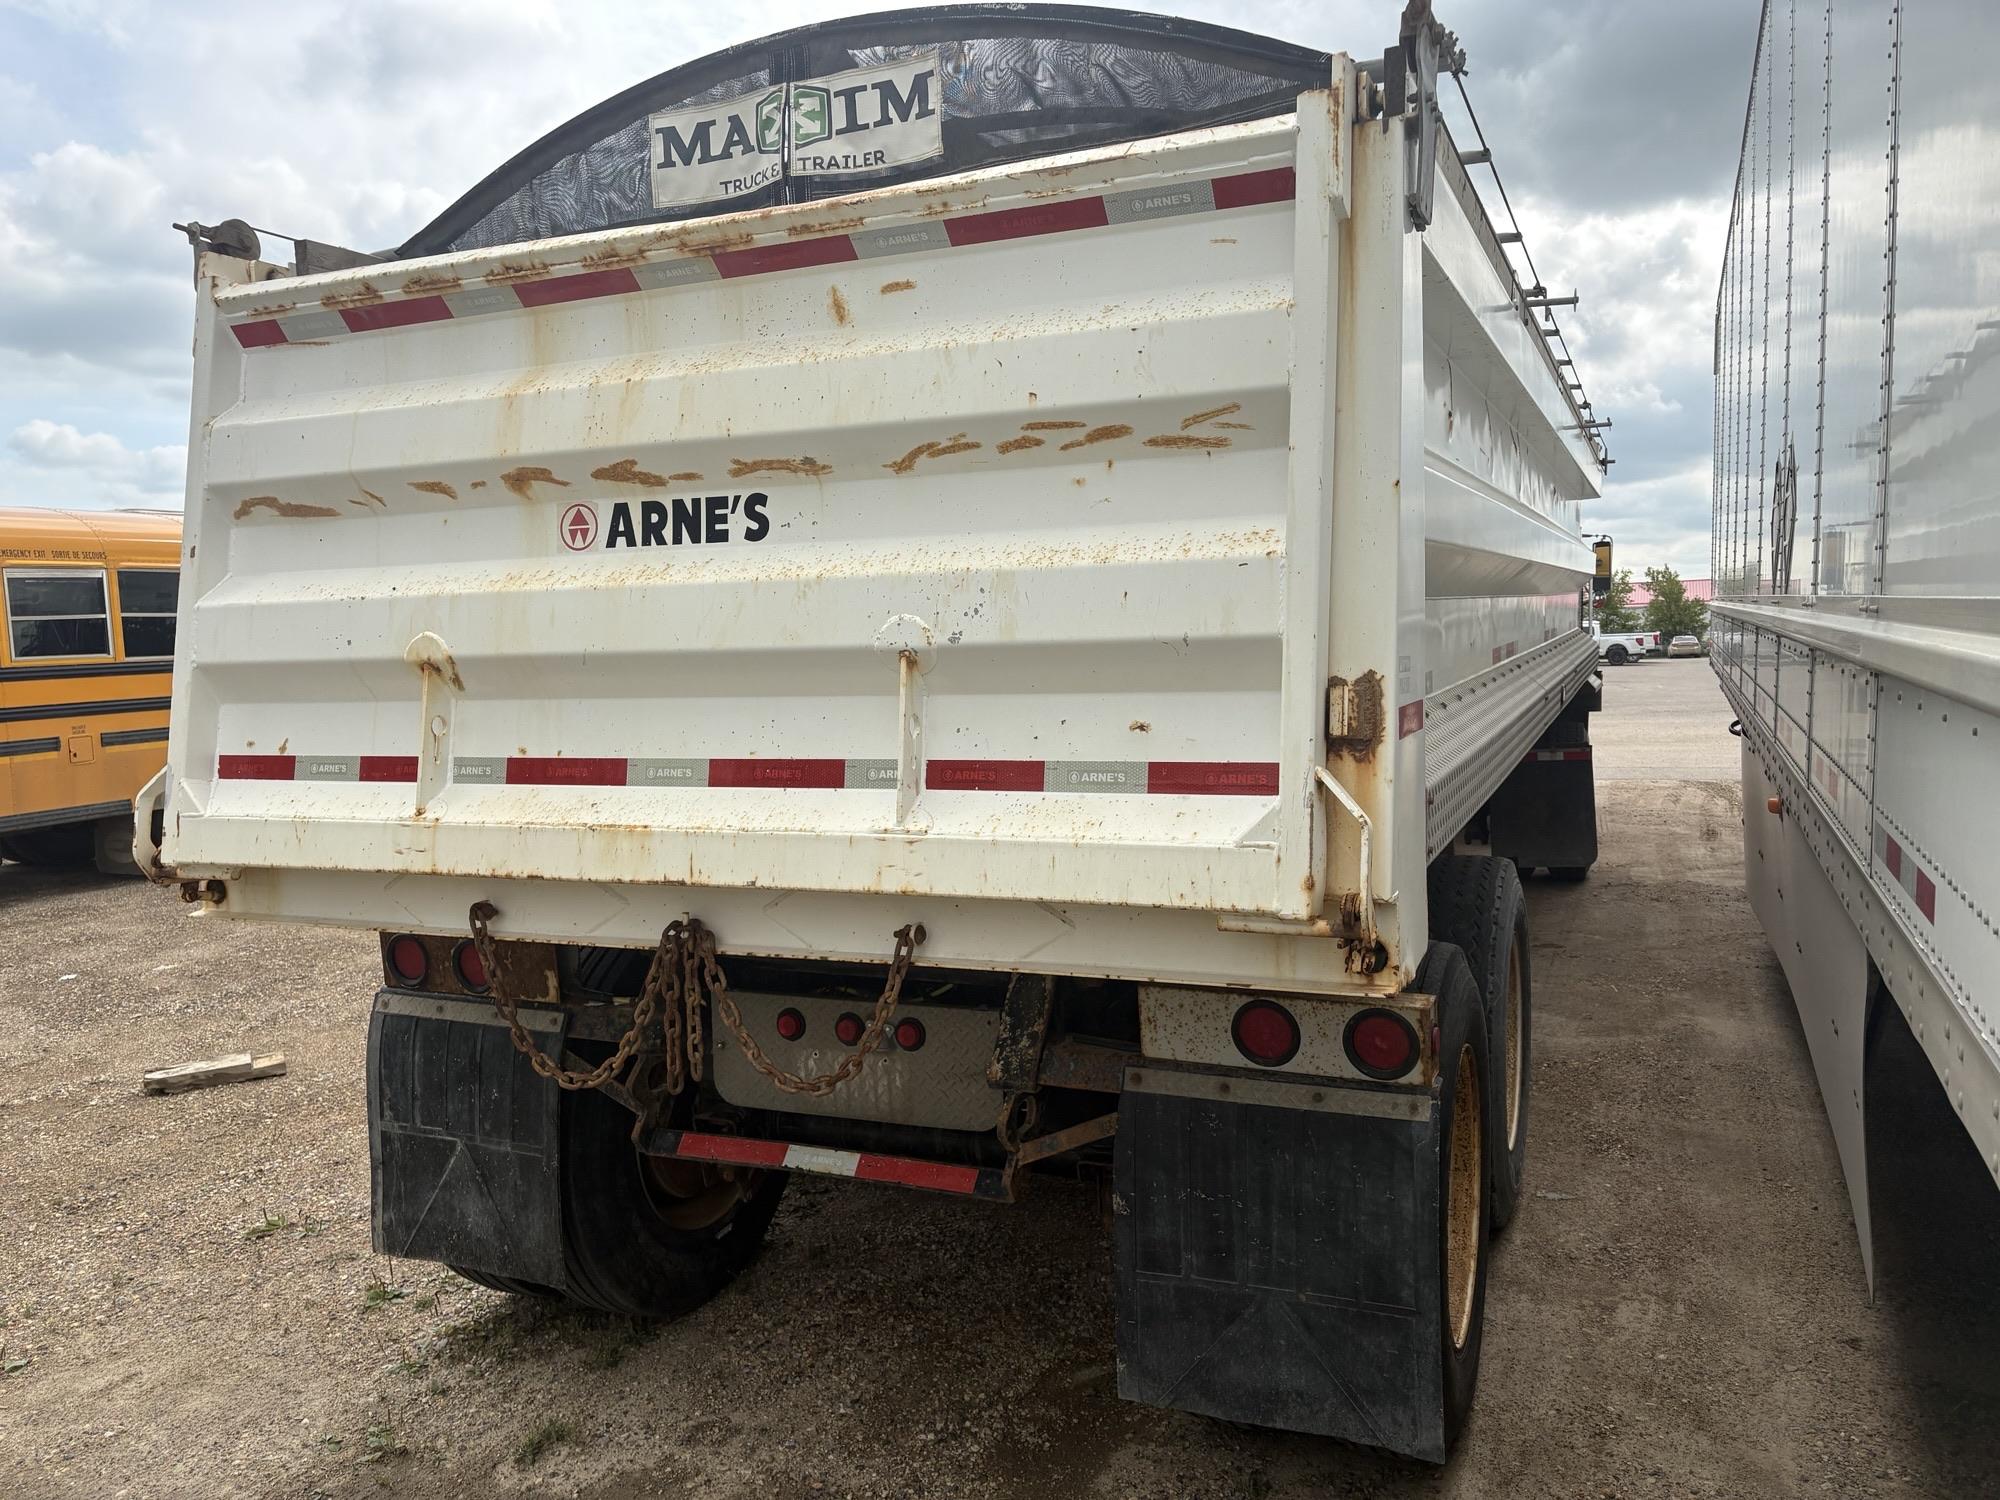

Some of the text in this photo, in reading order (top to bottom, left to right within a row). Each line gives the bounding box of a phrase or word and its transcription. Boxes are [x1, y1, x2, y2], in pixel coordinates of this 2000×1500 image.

[719, 166, 770, 196] TRUCK
[797, 149, 887, 172] TRAILER
[888, 231, 929, 247] ARNE'S
[1144, 193, 1192, 210] ARNE'S
[605, 492, 770, 548] ARNE'S
[33, 549, 46, 559] EXIT
[318, 764, 347, 774] ARNE'S
[460, 766, 492, 776] ARNE'S
[656, 768, 693, 778] ARNE'S
[954, 770, 996, 781] ARNE'S
[1080, 772, 1126, 783] ARNE'S
[1217, 774, 1268, 785] ARNE'S
